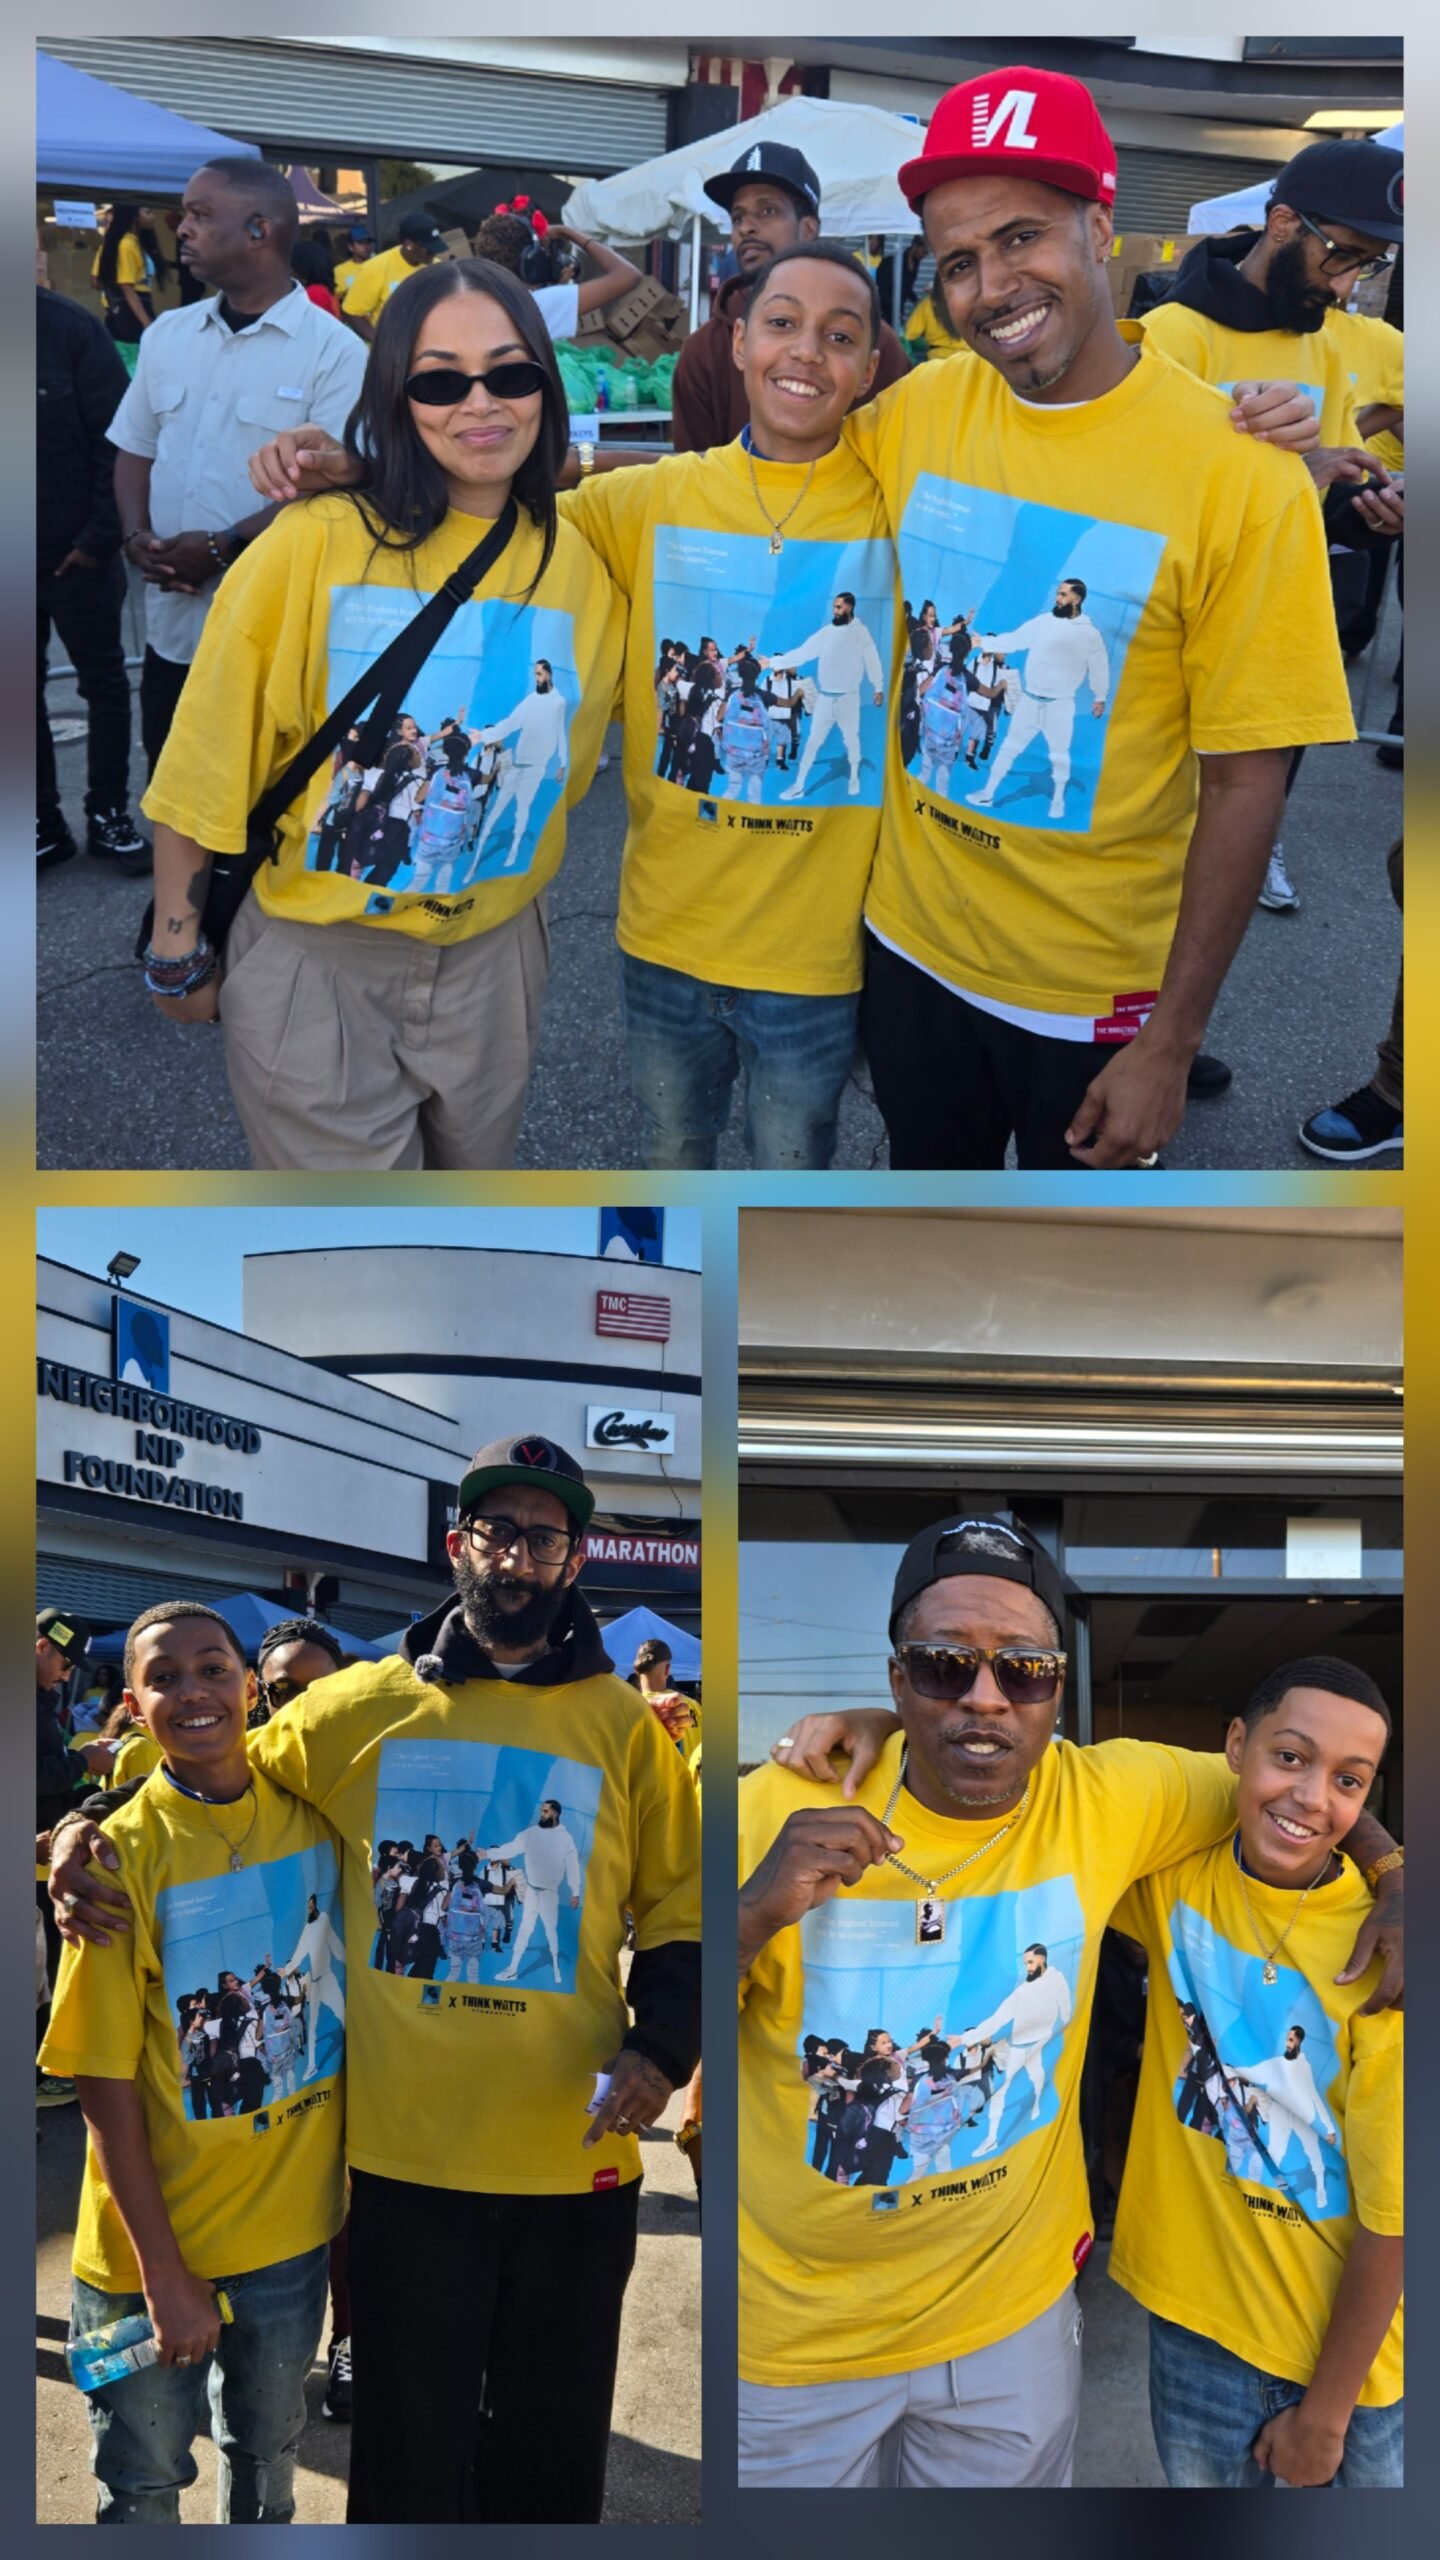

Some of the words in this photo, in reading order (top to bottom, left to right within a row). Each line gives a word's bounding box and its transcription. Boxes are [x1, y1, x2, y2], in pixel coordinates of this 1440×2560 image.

[727, 814, 736, 828] X
[741, 816, 773, 831] THINK
[775, 818, 814, 833] WATTS
[914, 799, 926, 815] X
[929, 806, 959, 831] THINK
[960, 821, 1001, 850] WATTS
[600, 1295, 628, 1312] TMC
[37, 1361, 262, 1454] NEIGHBORHOOD
[136, 1429, 185, 1468] NIP
[63, 1450, 244, 1520] FOUNDATION
[586, 1537, 699, 1565] MARATHON
[448, 1995, 457, 2008] X
[462, 1995, 491, 2009] THINK
[492, 1998, 527, 2013] WATTS
[912, 2193, 922, 2207] X
[930, 2181, 968, 2199] THINK
[970, 2165, 1007, 2191] WATTS
[1242, 2192, 1275, 2213] THINK
